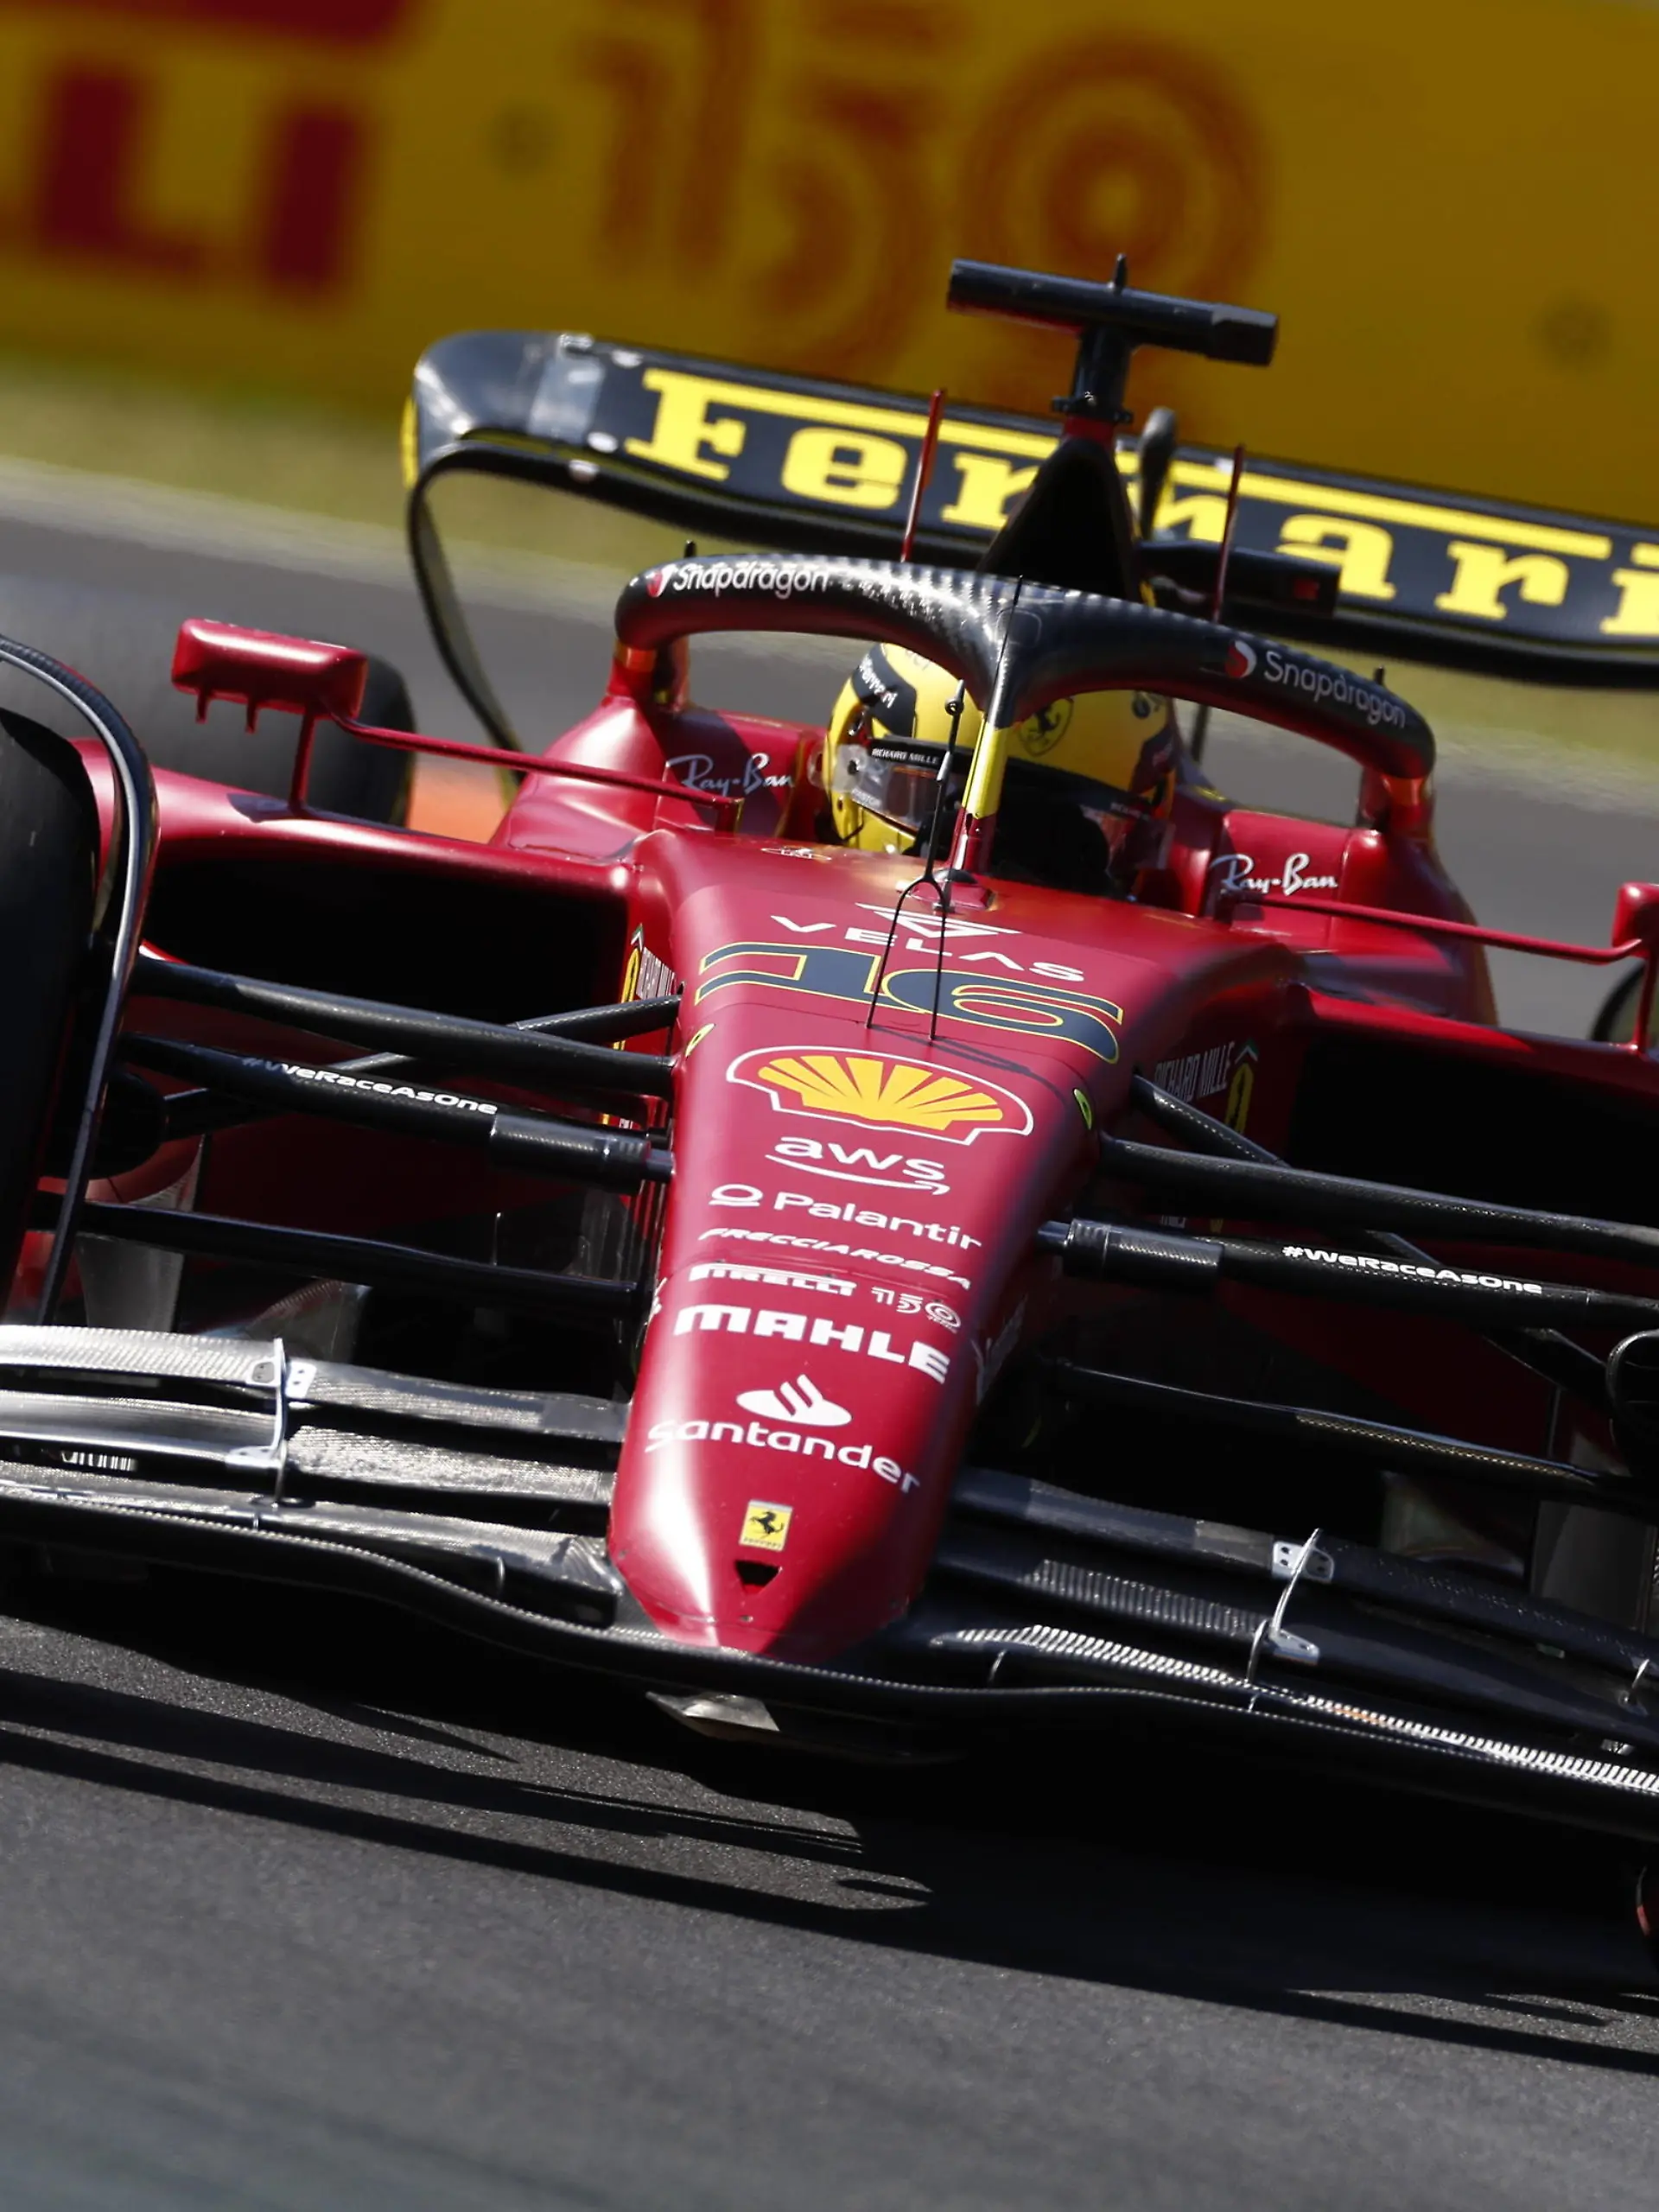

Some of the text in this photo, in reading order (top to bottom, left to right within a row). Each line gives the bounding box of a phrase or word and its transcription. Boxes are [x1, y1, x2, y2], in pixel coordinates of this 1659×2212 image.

[672, 562, 830, 601] Snapdragon
[1264, 652, 1407, 728] Snapdragon
[665, 753, 795, 797] Ray-Ban
[908, 752, 939, 765] MILLE
[1210, 852, 1339, 896] Ray-Ban
[769, 915, 1085, 982] VELAS
[695, 942, 1123, 1064] 16
[242, 1057, 498, 1116] #WeRaceAsOne
[774, 1136, 946, 1182] aws
[773, 1192, 982, 1250] Palantir
[698, 1227, 972, 1291] FRECCIAROSSA
[1281, 1245, 1542, 1295] #WeRaceAsOne
[689, 1262, 857, 1297] PIRELLI
[871, 1286, 962, 1329] 150
[673, 1304, 950, 1384] MAHLE
[645, 1419, 920, 1494] Santander
